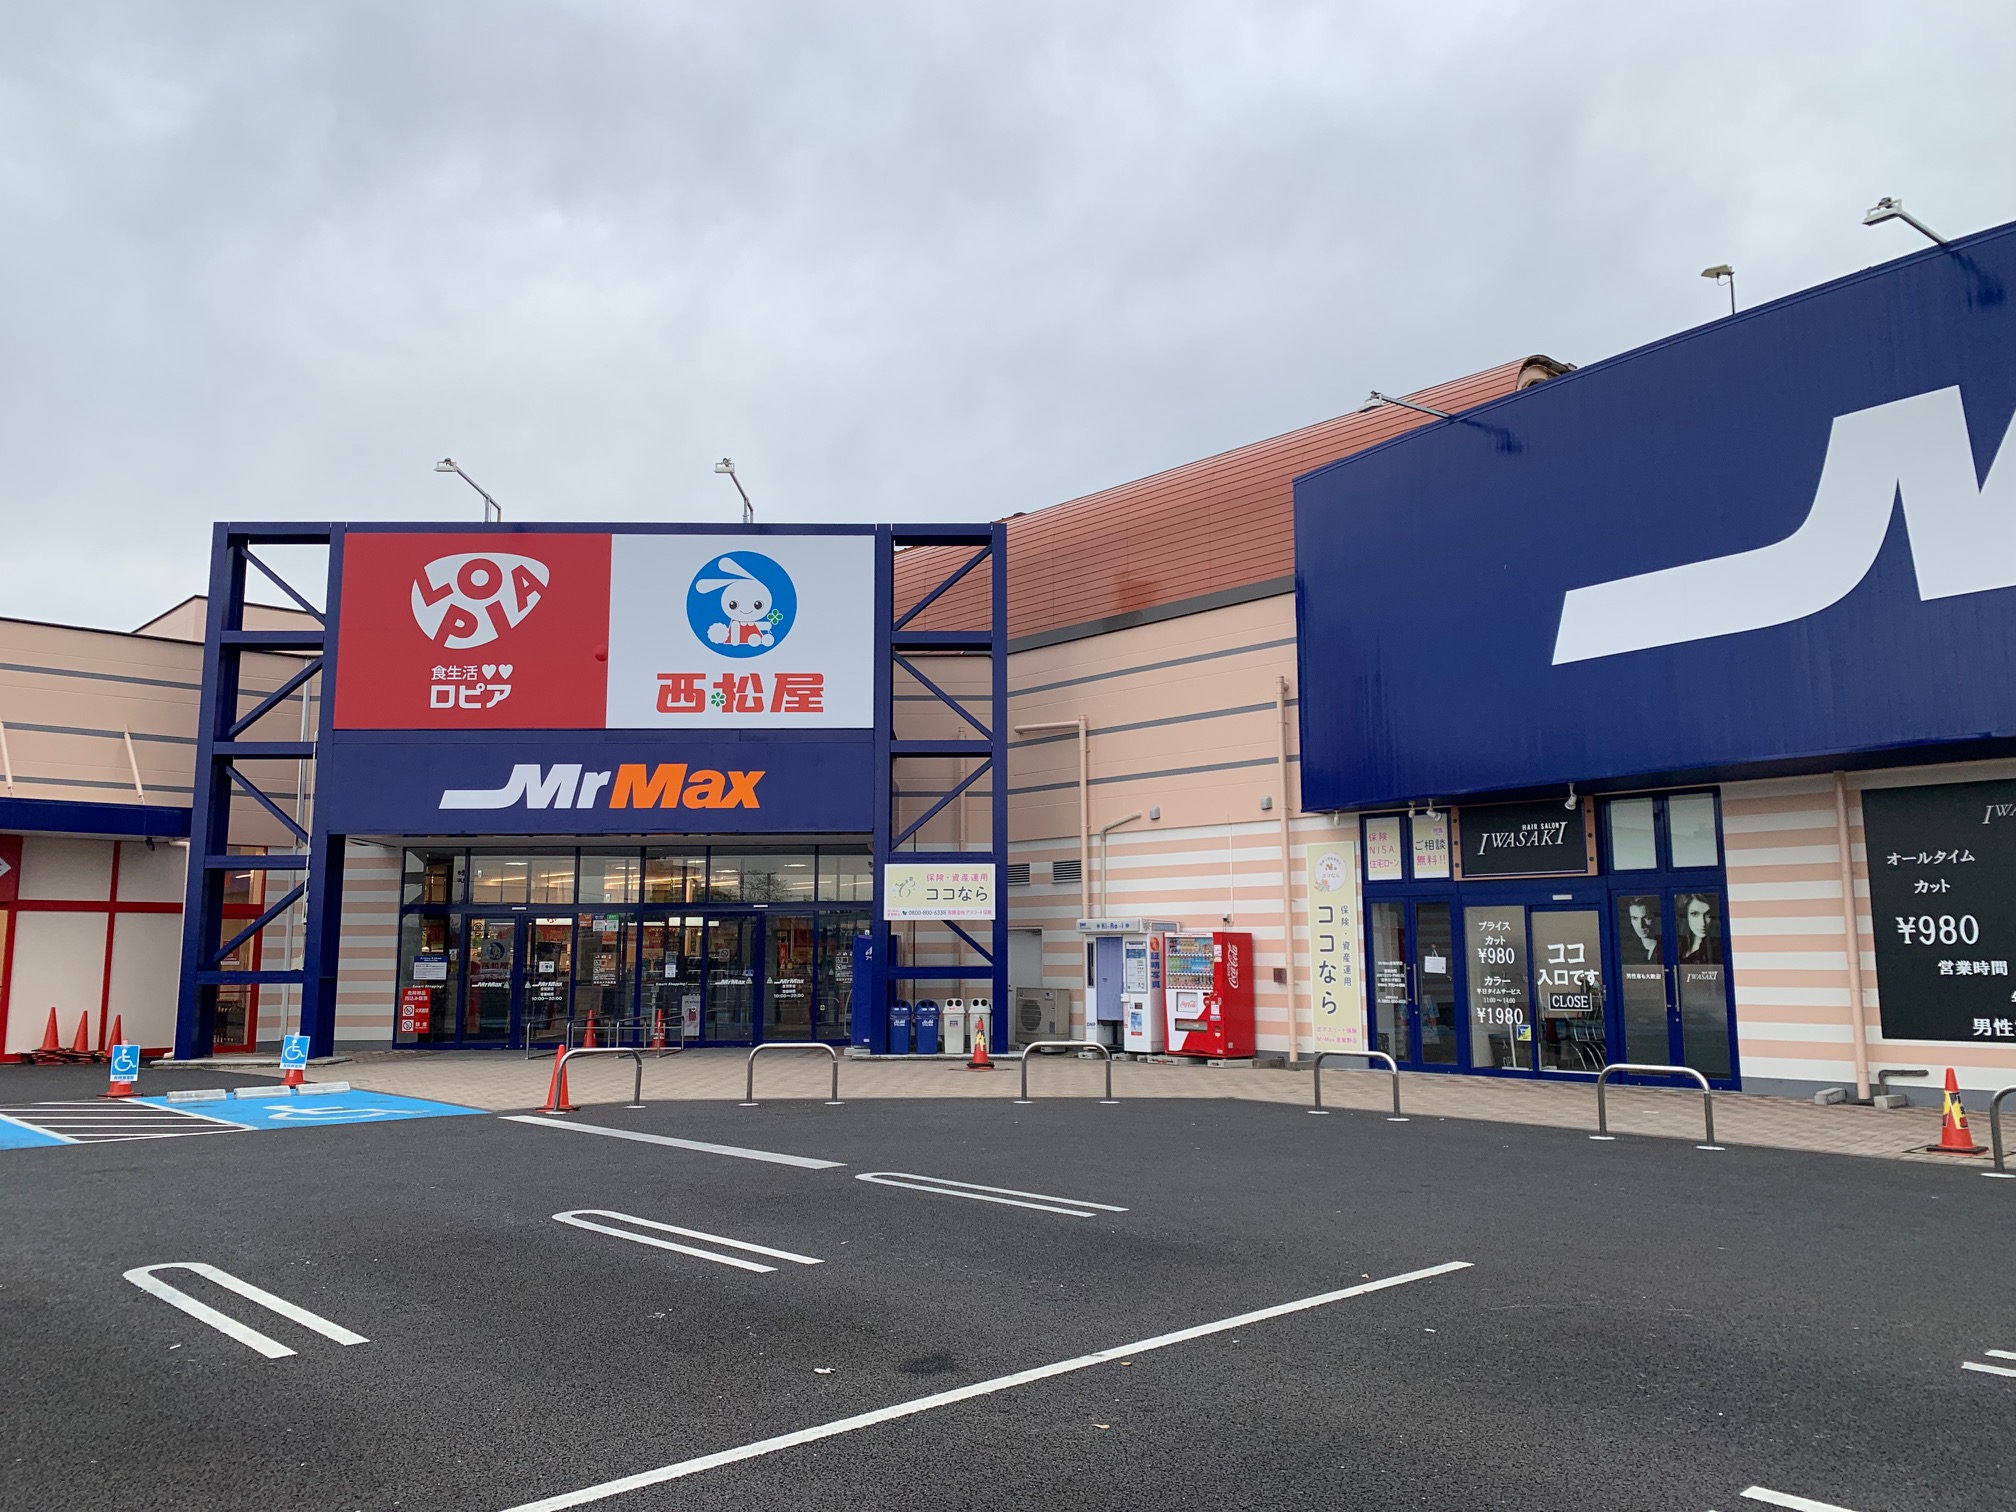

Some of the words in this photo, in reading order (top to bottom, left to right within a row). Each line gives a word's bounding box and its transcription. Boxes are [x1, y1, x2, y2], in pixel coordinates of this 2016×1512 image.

[412, 554, 550, 647] LOPIA
[430, 664, 479, 681] 食生活
[429, 682, 512, 710] ロピア
[656, 672, 825, 713] 西松屋
[438, 763, 766, 810] MrMax
[1521, 823, 1538, 831] HAIR
[1540, 822, 1560, 830] SALON
[1369, 831, 1388, 842] 保険
[1415, 838, 1446, 851] ご相談
[1477, 821, 1568, 856] IWASAKI
[1369, 845, 1395, 855] NISA
[1886, 849, 1976, 866] オールタイム
[1370, 858, 1400, 869] 住宅ローン
[926, 886, 988, 902] ココなら
[1913, 878, 1951, 894] カット
[1896, 914, 1979, 946] ¥980
[1340, 904, 1352, 987] 保険・資産運用
[1485, 935, 1506, 946] カット
[1317, 905, 1338, 1015] ココなら
[1477, 947, 1515, 965] ¥980
[1547, 943, 1586, 965] ココ
[1686, 970, 1718, 983] IWASAKI
[1938, 960, 2008, 976] 営業時間
[1484, 975, 1511, 986] カラー
[1537, 969, 1600, 986] 入口です
[1552, 995, 1589, 1009] CLOSE
[1476, 1007, 1524, 1025] ¥1980
